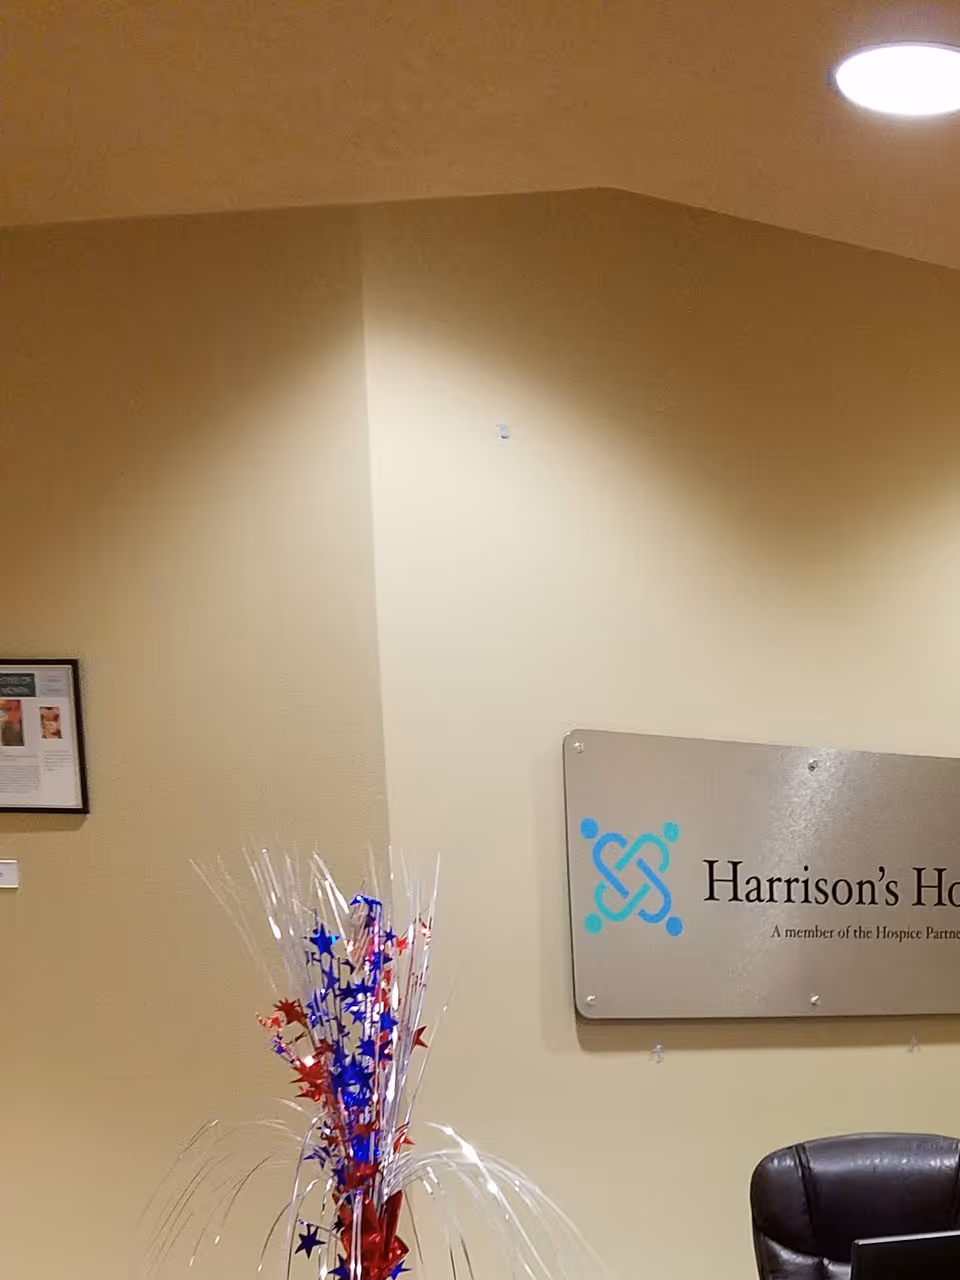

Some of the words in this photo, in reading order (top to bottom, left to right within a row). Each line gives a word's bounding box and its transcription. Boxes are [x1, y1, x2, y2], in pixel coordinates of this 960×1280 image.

[702, 859, 899, 906] Harrison's
[771, 925, 781, 938] A
[785, 925, 835, 939] member
[838, 925, 852, 939] of
[853, 925, 872, 940] the
[876, 926, 922, 943] Hospice
